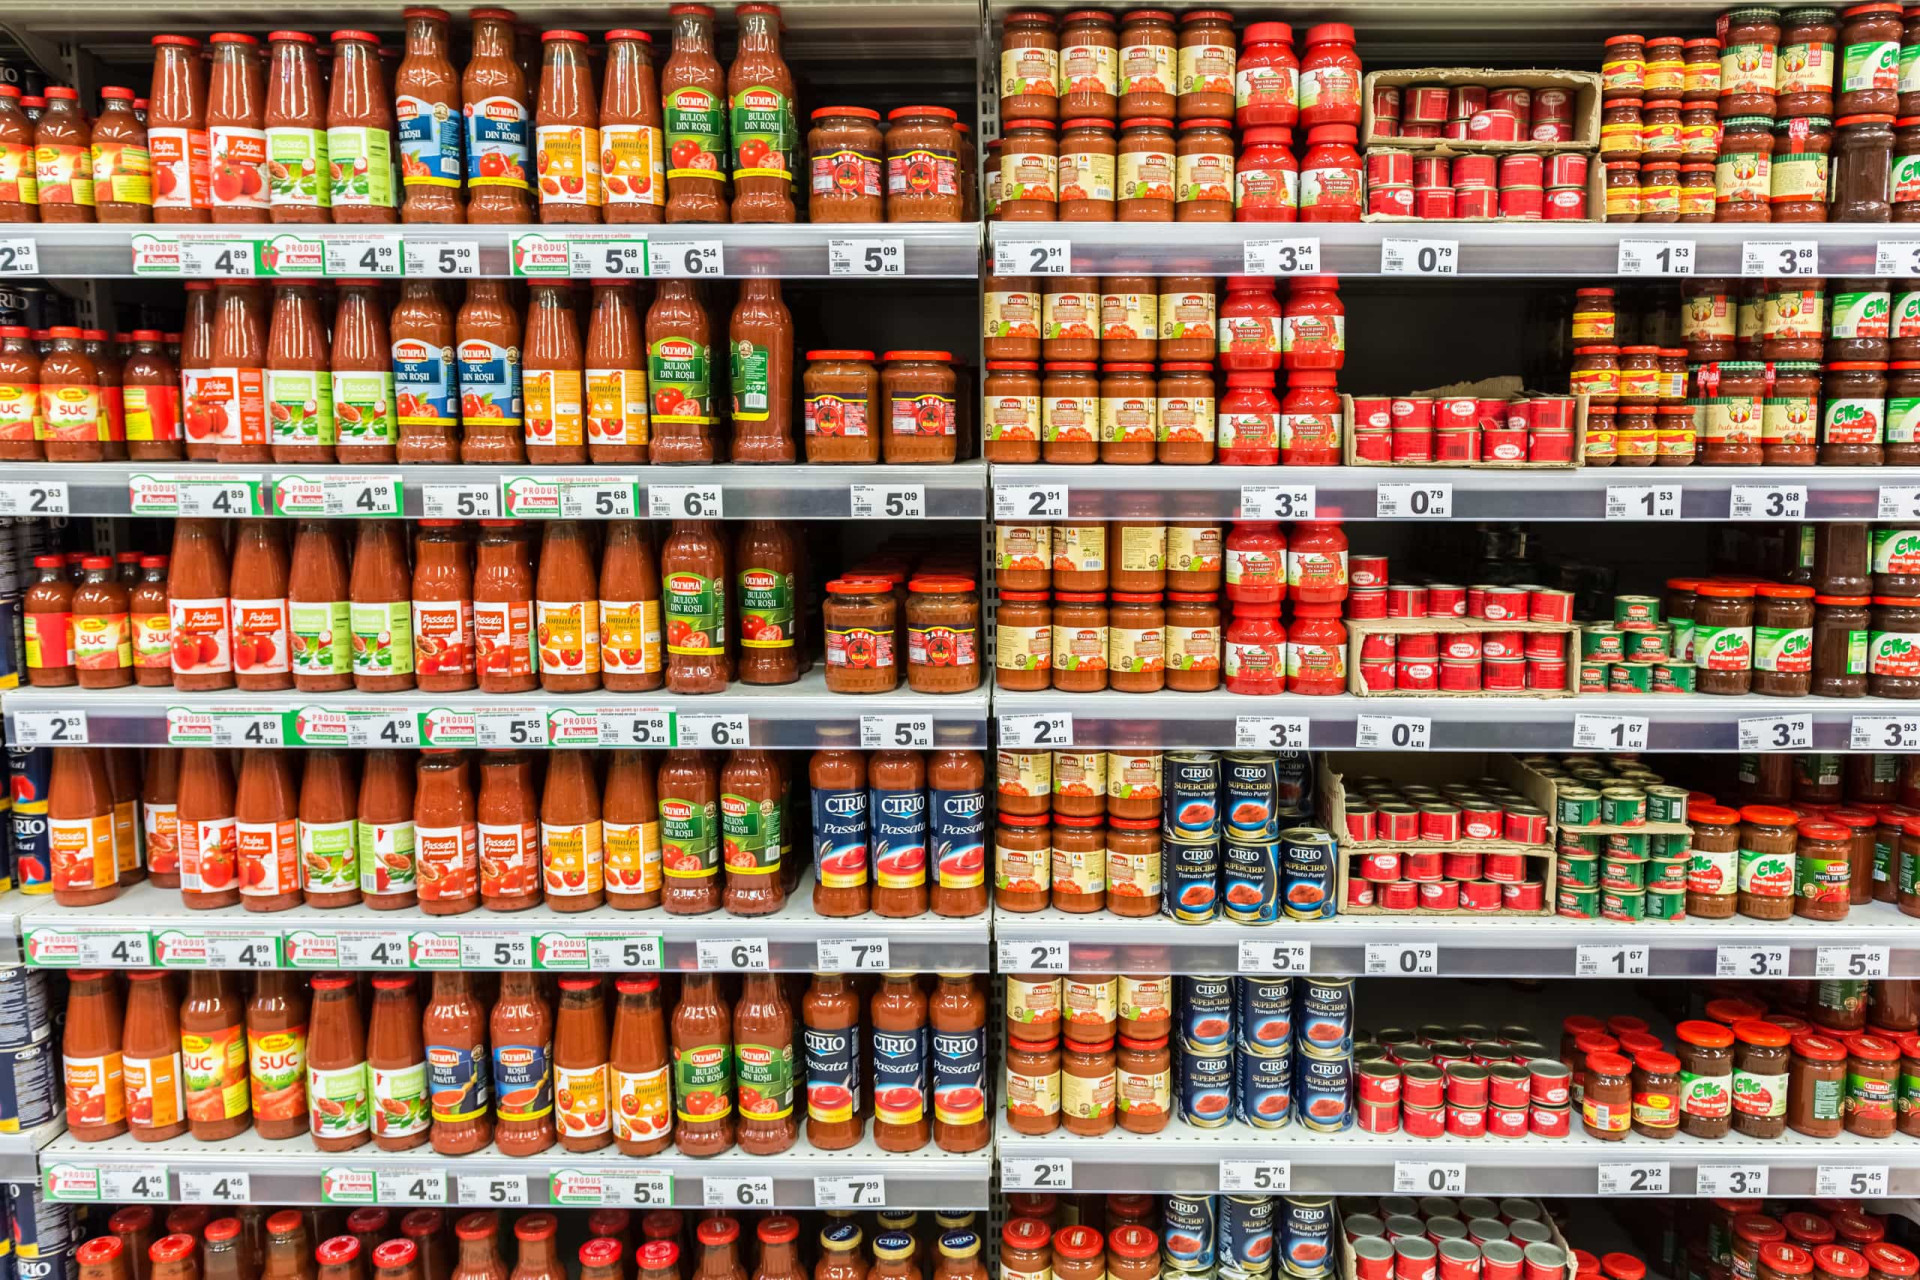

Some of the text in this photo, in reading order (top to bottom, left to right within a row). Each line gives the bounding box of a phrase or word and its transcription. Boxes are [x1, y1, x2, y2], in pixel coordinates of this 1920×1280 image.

[677, 96, 709, 107] OLYMPIA
[487, 105, 519, 117] OLYMPIA
[680, 113, 708, 122] BULION
[496, 123, 511, 131] SUC
[676, 122, 690, 131] DIN
[485, 131, 499, 139] DIN
[832, 154, 863, 166] SARAY
[532, 244, 567, 252] PRODUS
[215, 250, 235, 275] 4
[234, 250, 247, 259] 89
[439, 250, 457, 274] 5
[457, 249, 471, 258] 90
[864, 248, 883, 273] 5
[884, 247, 897, 256] 09
[1280, 247, 1298, 272] 3
[1299, 246, 1313, 255] 54
[1418, 248, 1437, 273] 0
[1439, 248, 1452, 257] 79
[1779, 250, 1813, 275] 3 68 LEI
[662, 345, 692, 356] OLYMPIA
[664, 362, 691, 371] BULION
[660, 371, 673, 379] DIN
[60, 405, 88, 416] SUC
[523, 487, 558, 495] PRODUS
[213, 490, 232, 514] 4
[232, 490, 244, 499] 89
[596, 492, 614, 515] 5
[614, 491, 627, 500] 68
[886, 493, 904, 517] 5
[904, 492, 918, 501] 09
[1411, 491, 1429, 515] 0
[1430, 491, 1444, 499] 79
[1766, 493, 1785, 517] 3
[1786, 493, 1800, 502] 68
[671, 581, 700, 590] OLYMPIA
[745, 576, 774, 585] OLYMPIA
[673, 596, 699, 605] BULION
[747, 591, 772, 599] BULION
[671, 604, 682, 612] DIN
[745, 599, 755, 607] DIN
[80, 635, 107, 645] SUC
[924, 631, 955, 640] SARAY
[440, 716, 475, 724] PRODUS
[563, 717, 598, 725] PRODUS
[245, 722, 264, 745] 4
[263, 722, 276, 730] 89
[443, 726, 473, 735] Auchan
[510, 721, 528, 744] 5
[528, 720, 541, 729] 55
[567, 727, 596, 736] Auchan
[895, 723, 913, 746] 5
[913, 722, 927, 731] 09
[1034, 721, 1053, 744] 2
[1052, 720, 1064, 729] 91
[1773, 724, 1791, 747] 3
[1792, 722, 1805, 731] 79
[1181, 768, 1213, 779] CIRIO
[1234, 768, 1267, 779] CIRIO
[1174, 781, 1218, 790] SUPERCIRIO
[1228, 780, 1272, 790] SUPERCIRIO
[1230, 789, 1253, 797] Tomato
[825, 795, 867, 813] CIRIO
[882, 796, 925, 814] CIRIO
[944, 795, 985, 814] CIRIO
[1289, 848, 1322, 860] CIRIO
[425, 939, 458, 947] PRODUS
[371, 943, 390, 965] 4
[389, 943, 402, 951] 99
[624, 944, 641, 967] 5
[641, 944, 654, 952] 68
[852, 946, 869, 968] 7
[870, 945, 883, 953] 99
[1273, 948, 1291, 970] 5
[1292, 948, 1305, 956] 76
[1848, 954, 1867, 977] 5
[1868, 954, 1881, 962] 45
[1196, 984, 1227, 995] CIRIO
[1310, 988, 1342, 999] CIRIO
[874, 1034, 917, 1052] CIRIO
[934, 1036, 978, 1054] CIRIO
[260, 1052, 298, 1070] SUC
[502, 1052, 531, 1062] OLYMPIA
[693, 1051, 721, 1062] OLYMPIA
[696, 1066, 721, 1076] BULION
[873, 1057, 919, 1074] Passata
[934, 1059, 981, 1075] Passata
[692, 1076, 704, 1084] DIN
[1034, 1165, 1052, 1186] 2
[1052, 1164, 1064, 1173] 91
[1254, 1168, 1271, 1189] 5
[1630, 1170, 1648, 1191] 2
[1649, 1169, 1662, 1177] 92
[409, 1179, 427, 1201] 4
[427, 1179, 439, 1187] 99
[737, 1184, 755, 1205] 6
[1292, 1208, 1325, 1220] CIRIO
[878, 1238, 909, 1247] CIRIO
[944, 1235, 974, 1246] CIRIO
